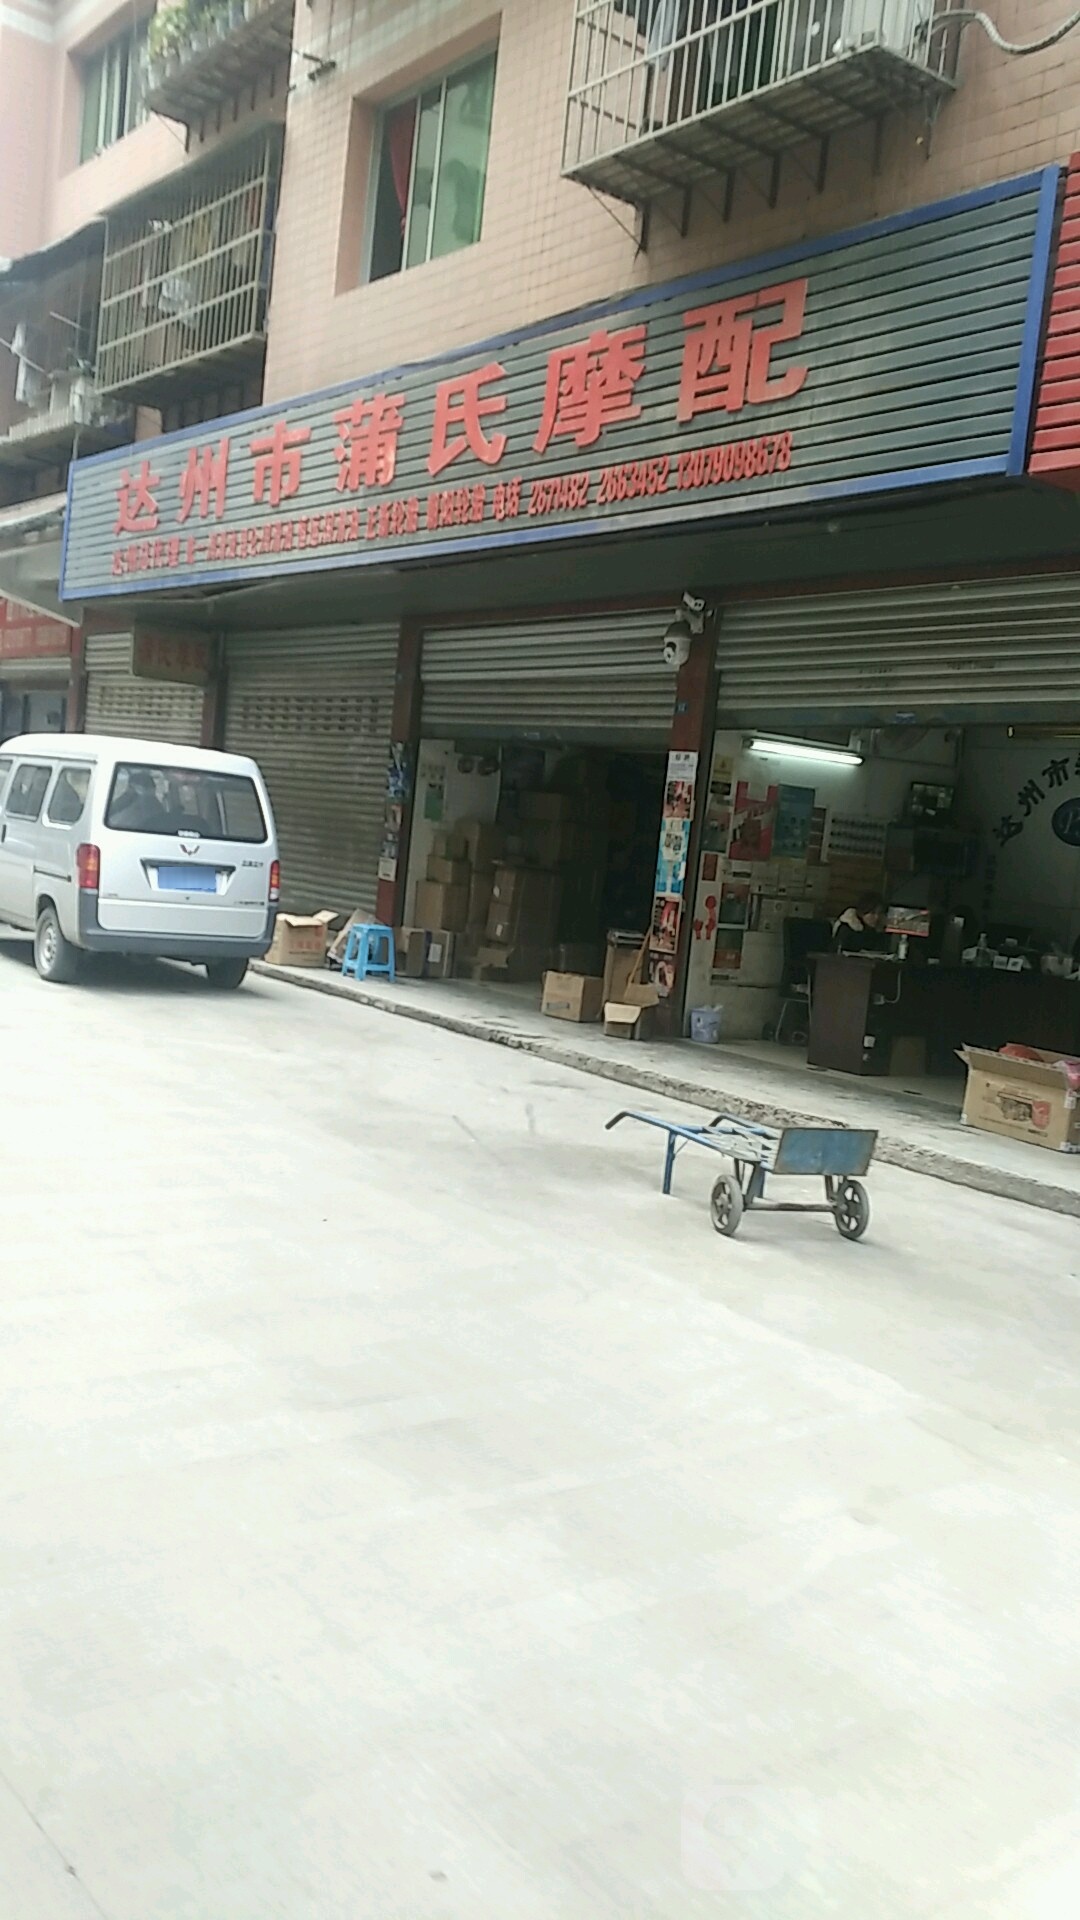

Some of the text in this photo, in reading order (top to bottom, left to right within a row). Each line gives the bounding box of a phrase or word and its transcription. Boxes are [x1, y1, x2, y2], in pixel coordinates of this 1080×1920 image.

[113, 278, 810, 535] 达州市蒲氏摩配
[493, 475, 523, 520] 电话
[527, 471, 589, 515] 2671482
[596, 456, 671, 504] 2663452
[675, 431, 793, 490] 13079098678
